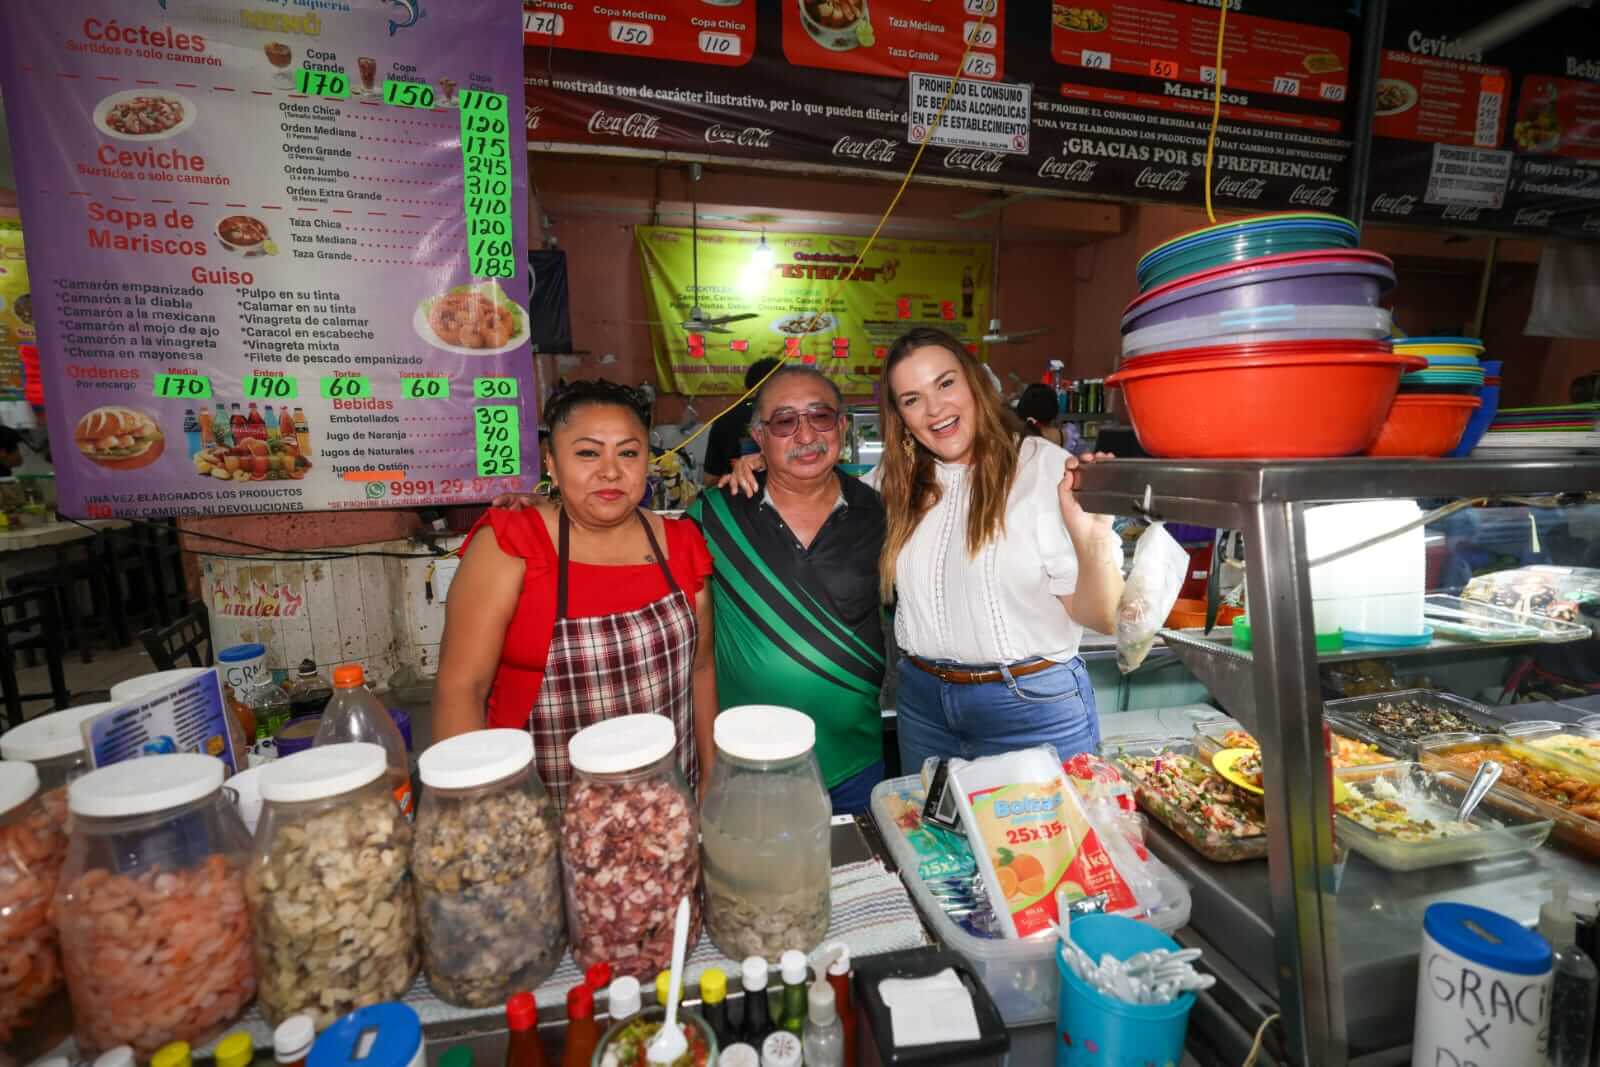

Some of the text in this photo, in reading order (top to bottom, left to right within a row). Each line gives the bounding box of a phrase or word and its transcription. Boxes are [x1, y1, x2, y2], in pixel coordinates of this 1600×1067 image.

[593, 6, 667, 22] Copa Mediana
[691, 17, 747, 31] Copa Chica
[889, 17, 945, 33] Taza Mediana
[83, 16, 207, 51] Cócteles
[616, 26, 648, 44] 150
[703, 36, 730, 52] 110
[66, 40, 222, 67] Surtidos solo camarón
[306, 48, 336, 62] Copa
[888, 47, 939, 62] Taza Grande
[303, 60, 344, 73] Grande
[393, 62, 417, 72] Copa
[967, 58, 994, 75] 185
[301, 72, 344, 95] 170
[919, 78, 1022, 103] PROHIBDO EL CONSUMO
[389, 83, 434, 107] 150
[463, 91, 502, 111] 110
[552, 80, 614, 96] mostradas
[616, 85, 637, 97] son
[639, 86, 654, 98] de
[656, 87, 703, 104] carácter
[770, 100, 789, 113] por
[792, 100, 802, 111] lo
[804, 104, 824, 117] que
[826, 106, 864, 120] pueden
[866, 108, 899, 123] diferir
[1164, 82, 1248, 106] Mariscos
[279, 102, 341, 117] Orden Chica
[917, 95, 1026, 119] DE ALCOHOLICAS
[467, 115, 505, 132] 120
[588, 110, 662, 139] Coca-Cola
[913, 111, 924, 125] EN
[951, 116, 1027, 136] ESTABLECIMIENTO
[1051, 103, 1195, 129] PROHIBE EL CONSUMO BEBIDAS
[281, 123, 311, 135] Orden
[314, 125, 357, 138] Mediana
[704, 124, 774, 149] Coca-Cola
[1060, 120, 1077, 132] VEZ
[1079, 124, 1138, 138] ELABORADOS
[1139, 131, 1156, 141] LOS
[282, 143, 313, 156] Orden
[315, 145, 352, 158] Grande
[466, 137, 505, 158] 175
[832, 136, 899, 163] Coca-Cola
[97, 144, 205, 172] Ceviche
[469, 156, 508, 177] 245
[943, 147, 1006, 173] Coca-Cola
[1062, 137, 1333, 182] ¡GRACIAS POR PREFERENCIA!
[77, 163, 230, 186] Surtidos solo camarón
[284, 165, 315, 177] Orden
[317, 167, 350, 179] Jumbo
[1038, 156, 1098, 182] Coca-Cola
[468, 176, 506, 197] 310
[1135, 166, 1190, 192] Coca-Cola
[1215, 175, 1267, 200] Coca-Cola
[286, 186, 383, 201] Orden Extra Grande
[1289, 184, 1339, 207] Coca-Cola
[87, 202, 194, 229] Sopa de
[469, 198, 506, 221] 410
[289, 217, 342, 230] Taza Chica
[471, 218, 505, 237] 120
[87, 228, 207, 257] Mariscos
[291, 232, 358, 246] Taza Mediana
[293, 249, 352, 262] Taza Grande
[476, 240, 513, 257] 160
[191, 266, 254, 286] Guiso
[474, 258, 513, 278] 185
[122, 283, 204, 298] empanizado
[296, 290, 311, 301] su
[313, 289, 341, 301] tinta
[151, 297, 193, 310] diabla
[330, 303, 357, 315] tinta
[152, 310, 216, 323] mexicana
[323, 316, 369, 327] calamar
[143, 324, 220, 338] mojo de ajo
[312, 328, 375, 341] escabeche
[155, 338, 217, 350] vinagreta
[307, 341, 340, 352] mixta
[138, 350, 203, 362] mayonesa
[285, 353, 300, 363] de
[303, 354, 352, 367] pescado
[355, 355, 423, 367] empanizado
[65, 365, 140, 379] Ordenes
[95, 381, 137, 391] encargo
[162, 376, 204, 395] 170
[251, 377, 291, 398] 190
[329, 378, 361, 396] 60
[411, 380, 440, 397] 60
[480, 379, 511, 397] 30
[332, 398, 394, 410] Bebidas
[329, 414, 400, 424] Embotellados
[476, 407, 509, 424] 30
[326, 431, 407, 441] Jugo de Naranja
[483, 425, 509, 442] 40
[321, 447, 415, 458] Jugos de Naturales
[484, 443, 513, 459] 40
[332, 462, 410, 473] Jugos Ostión
[482, 459, 515, 475] 25
[137, 488, 303, 503] ELABORADOS LOS PRODUCTOS
[390, 480, 435, 496] 9991
[440, 479, 464, 494] 29
[217, 501, 304, 514] DEVOLUCIONES
